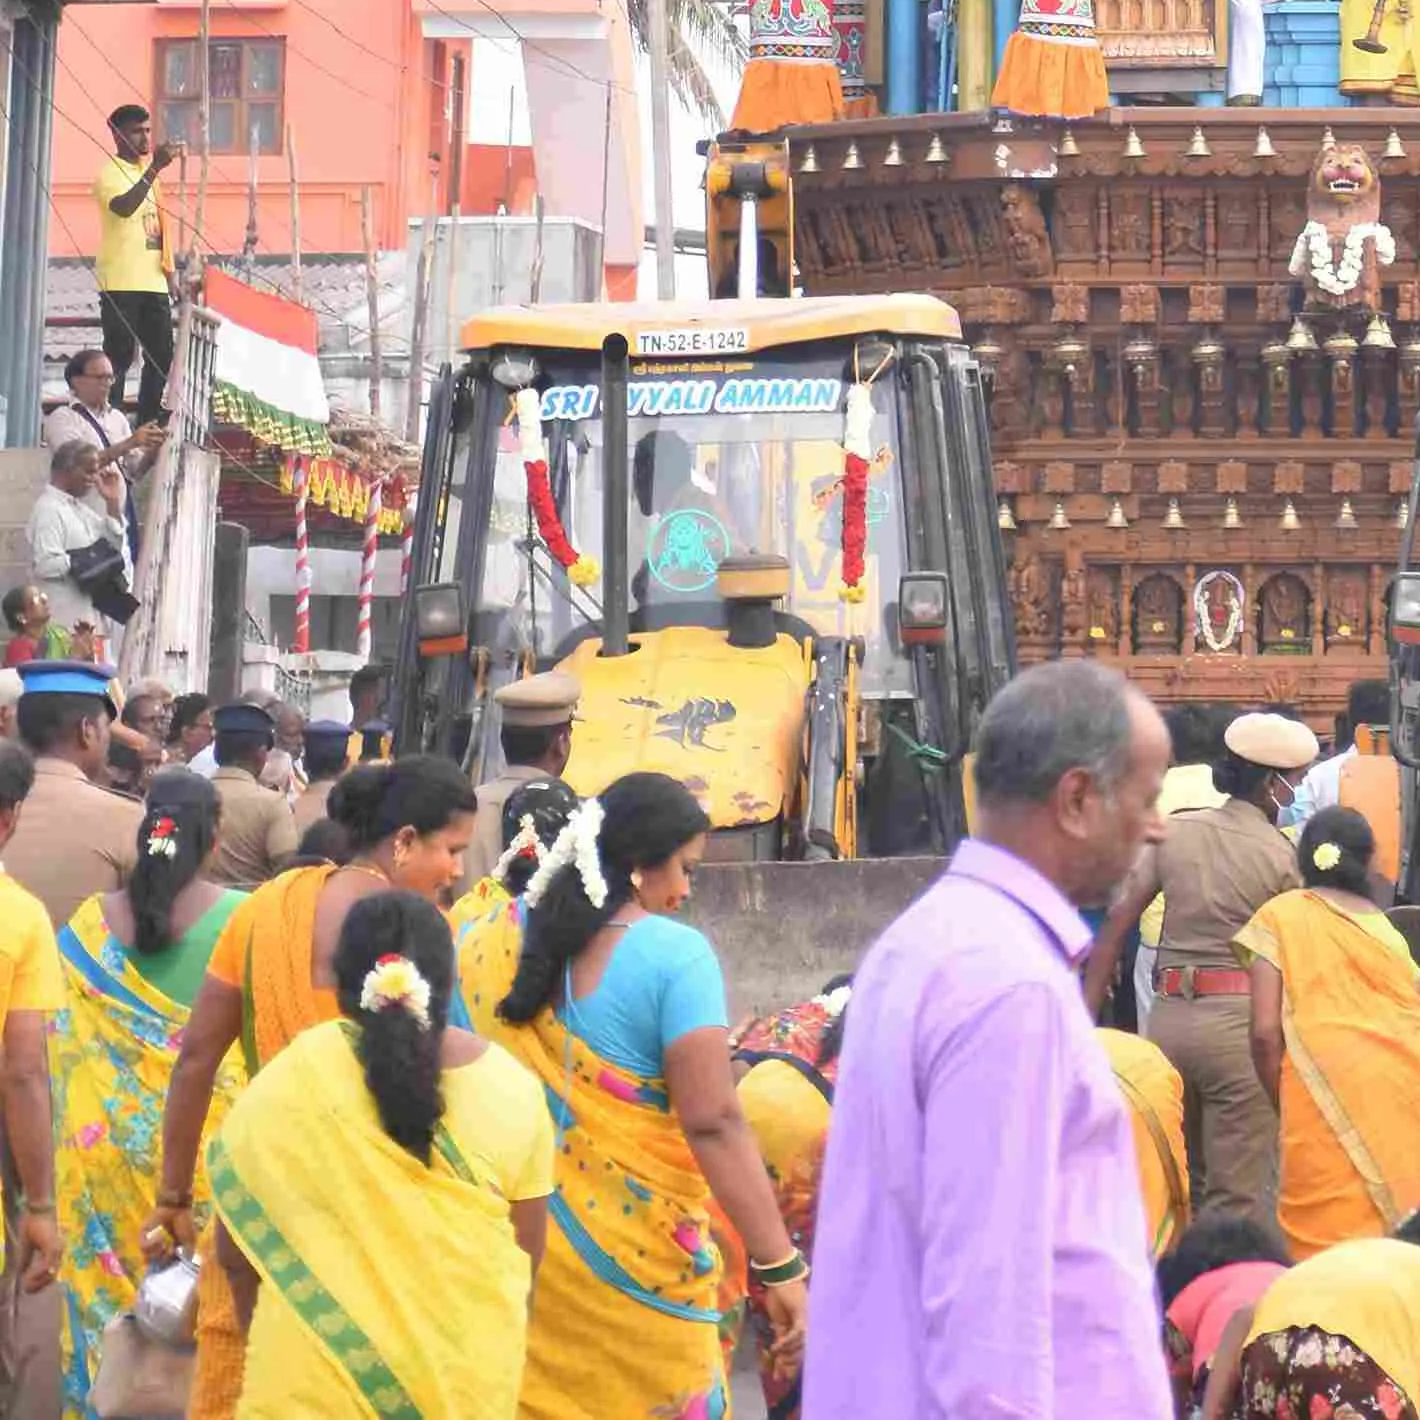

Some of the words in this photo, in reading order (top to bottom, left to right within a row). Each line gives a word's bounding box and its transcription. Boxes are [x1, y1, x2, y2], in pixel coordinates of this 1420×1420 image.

[640, 331, 745, 352] TN-52-E-1242
[541, 385, 599, 420] SRI
[600, 379, 716, 416] YYALI
[715, 378, 840, 413] AMMAN
